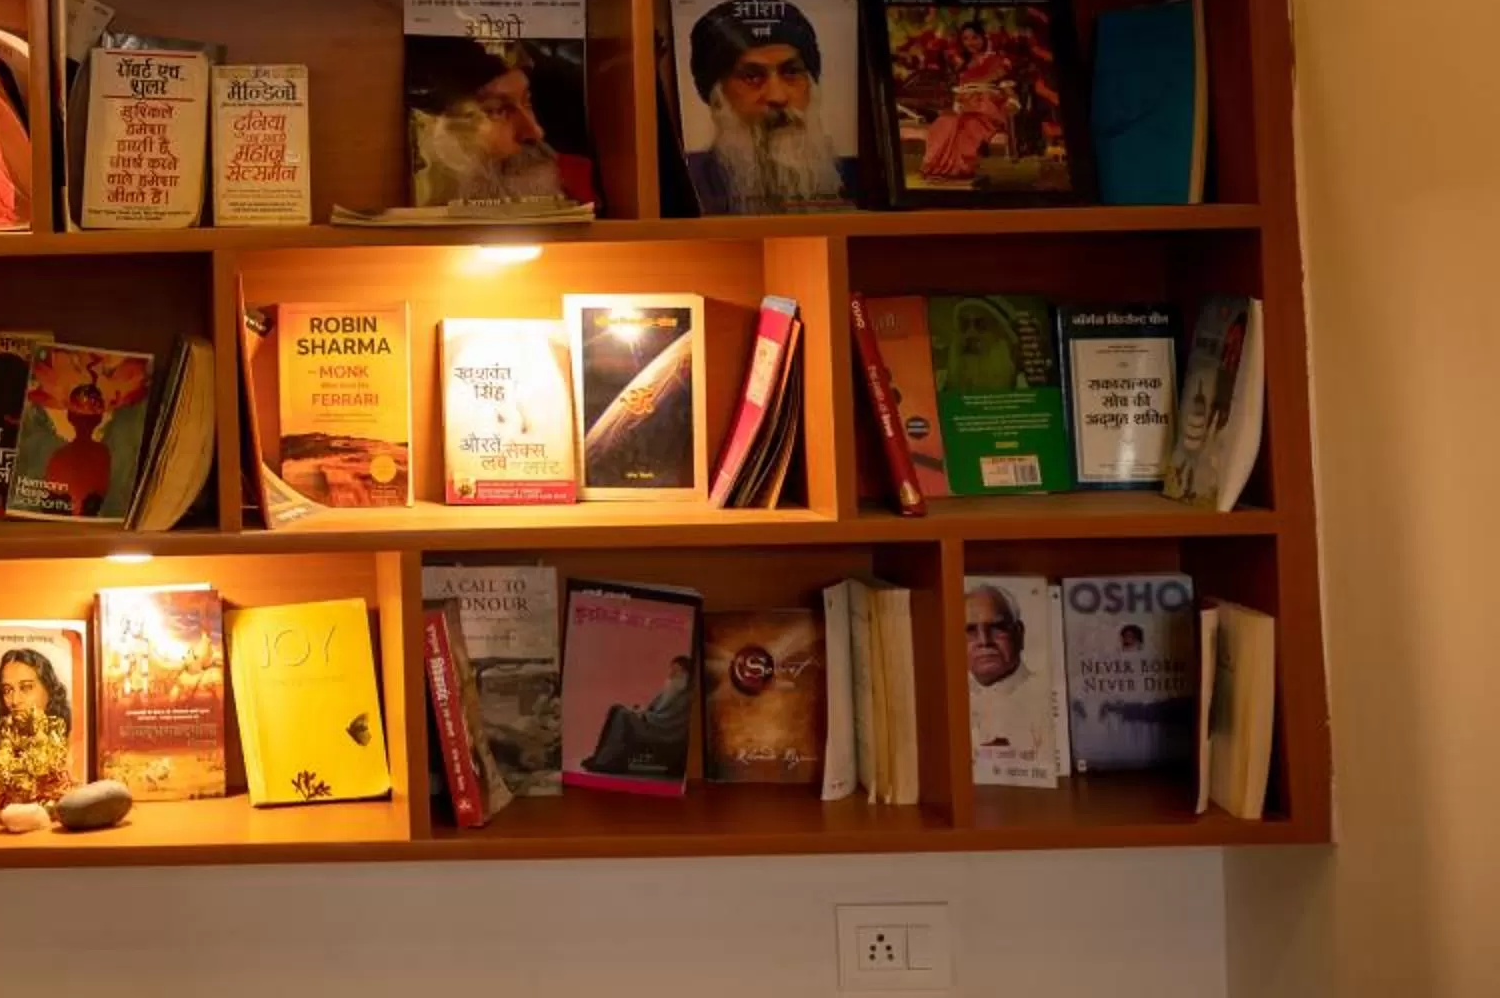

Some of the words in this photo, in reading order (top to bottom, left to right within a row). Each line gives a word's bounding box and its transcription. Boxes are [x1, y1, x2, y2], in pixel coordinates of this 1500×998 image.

[464, 13, 525, 38] ओशो
[309, 316, 377, 334] ROBIN
[296, 337, 391, 356] SHARMA
[319, 365, 369, 379] MONK
[311, 393, 380, 407] FERRARI
[443, 579, 454, 593] A
[458, 578, 501, 593] CALL
[503, 578, 527, 593] TO
[459, 596, 530, 612] ONOUR
[1069, 581, 1193, 615] OSHO
